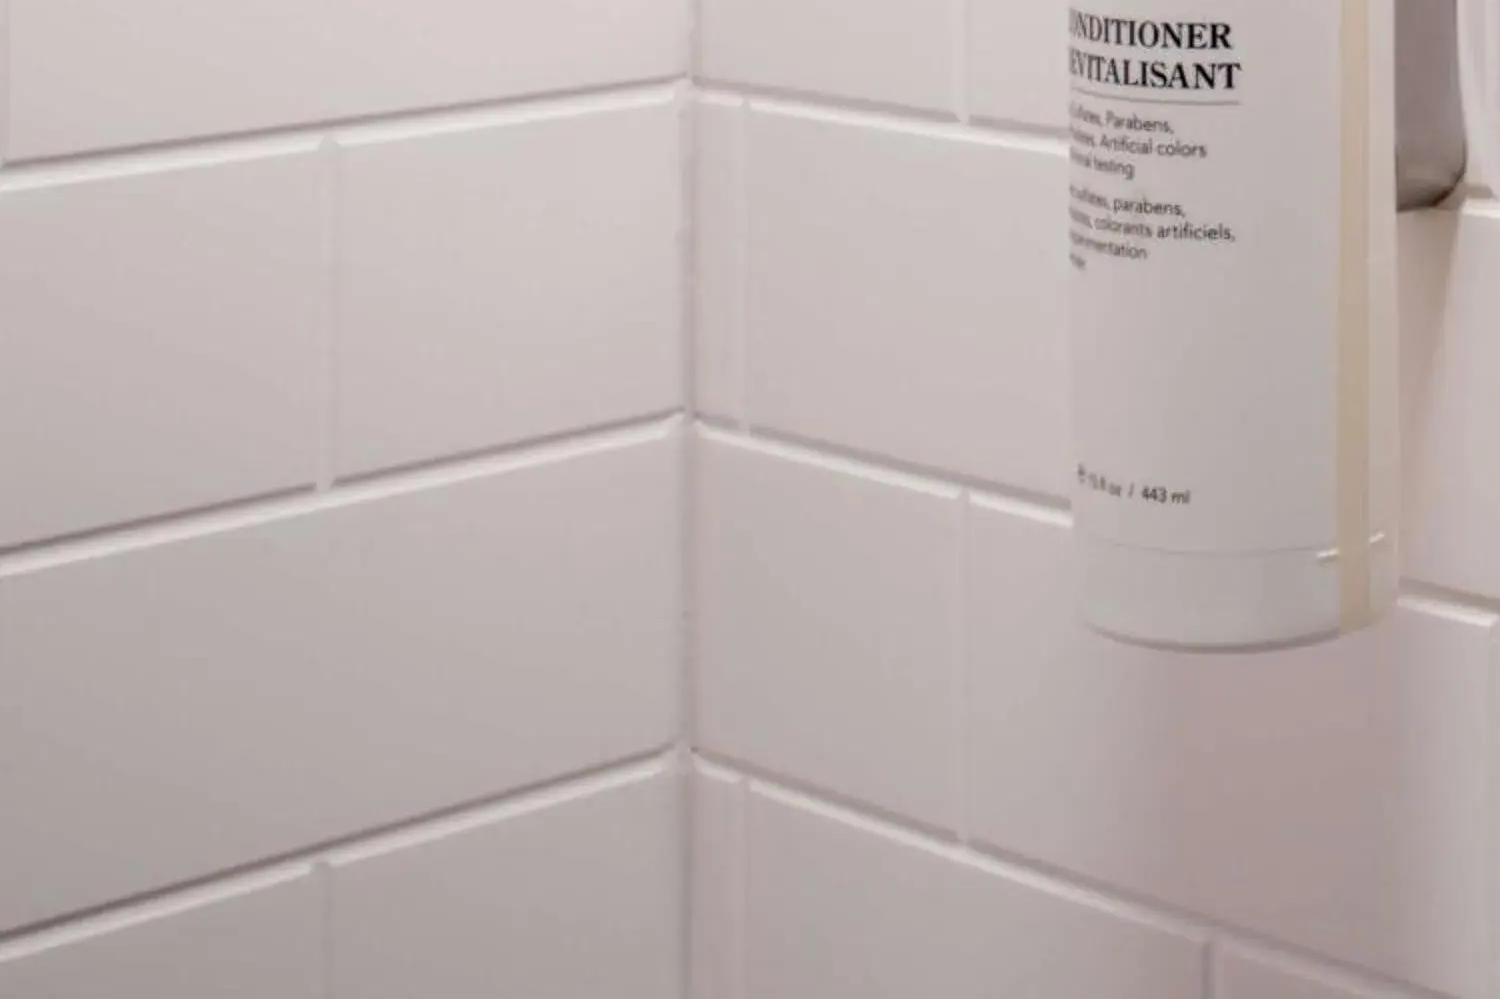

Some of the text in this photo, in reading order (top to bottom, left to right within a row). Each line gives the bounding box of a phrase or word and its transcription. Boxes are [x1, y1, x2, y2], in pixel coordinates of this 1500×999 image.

[1069, 9, 1233, 51] NDITIONER
[1069, 46, 1243, 89] EVITALISANT
[1105, 110, 1174, 134] Parabens,
[1156, 140, 1208, 159] colors
[1113, 197, 1186, 218] parabens,
[1157, 221, 1236, 242] artificiels,
[1141, 485, 1168, 504] 443
